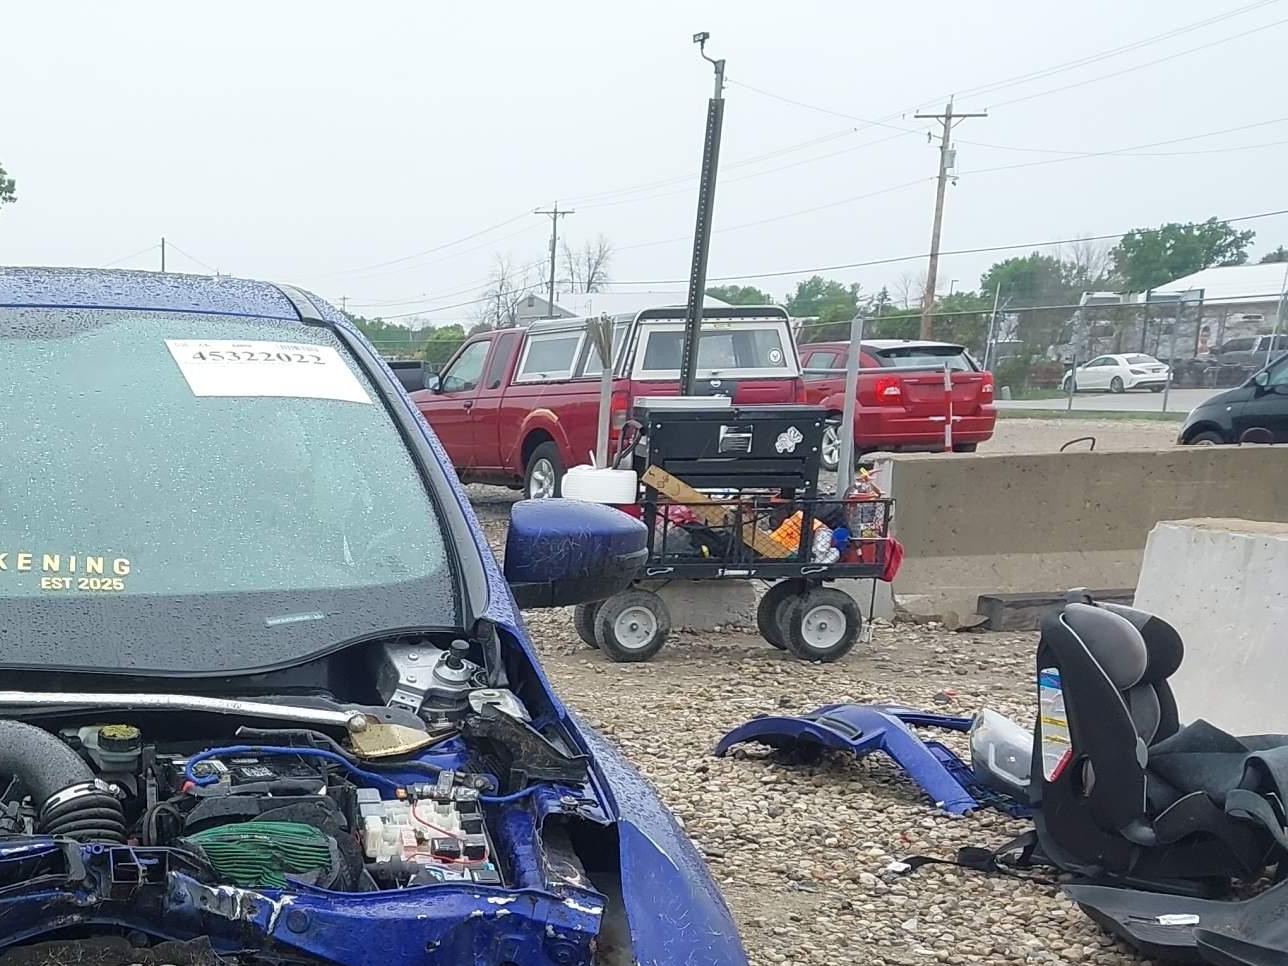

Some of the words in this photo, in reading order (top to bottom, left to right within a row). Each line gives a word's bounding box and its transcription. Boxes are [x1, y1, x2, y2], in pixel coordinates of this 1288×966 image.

[192, 350, 326, 365] 45322022
[40, 577, 72, 590] EST
[77, 577, 125, 591] 2025
